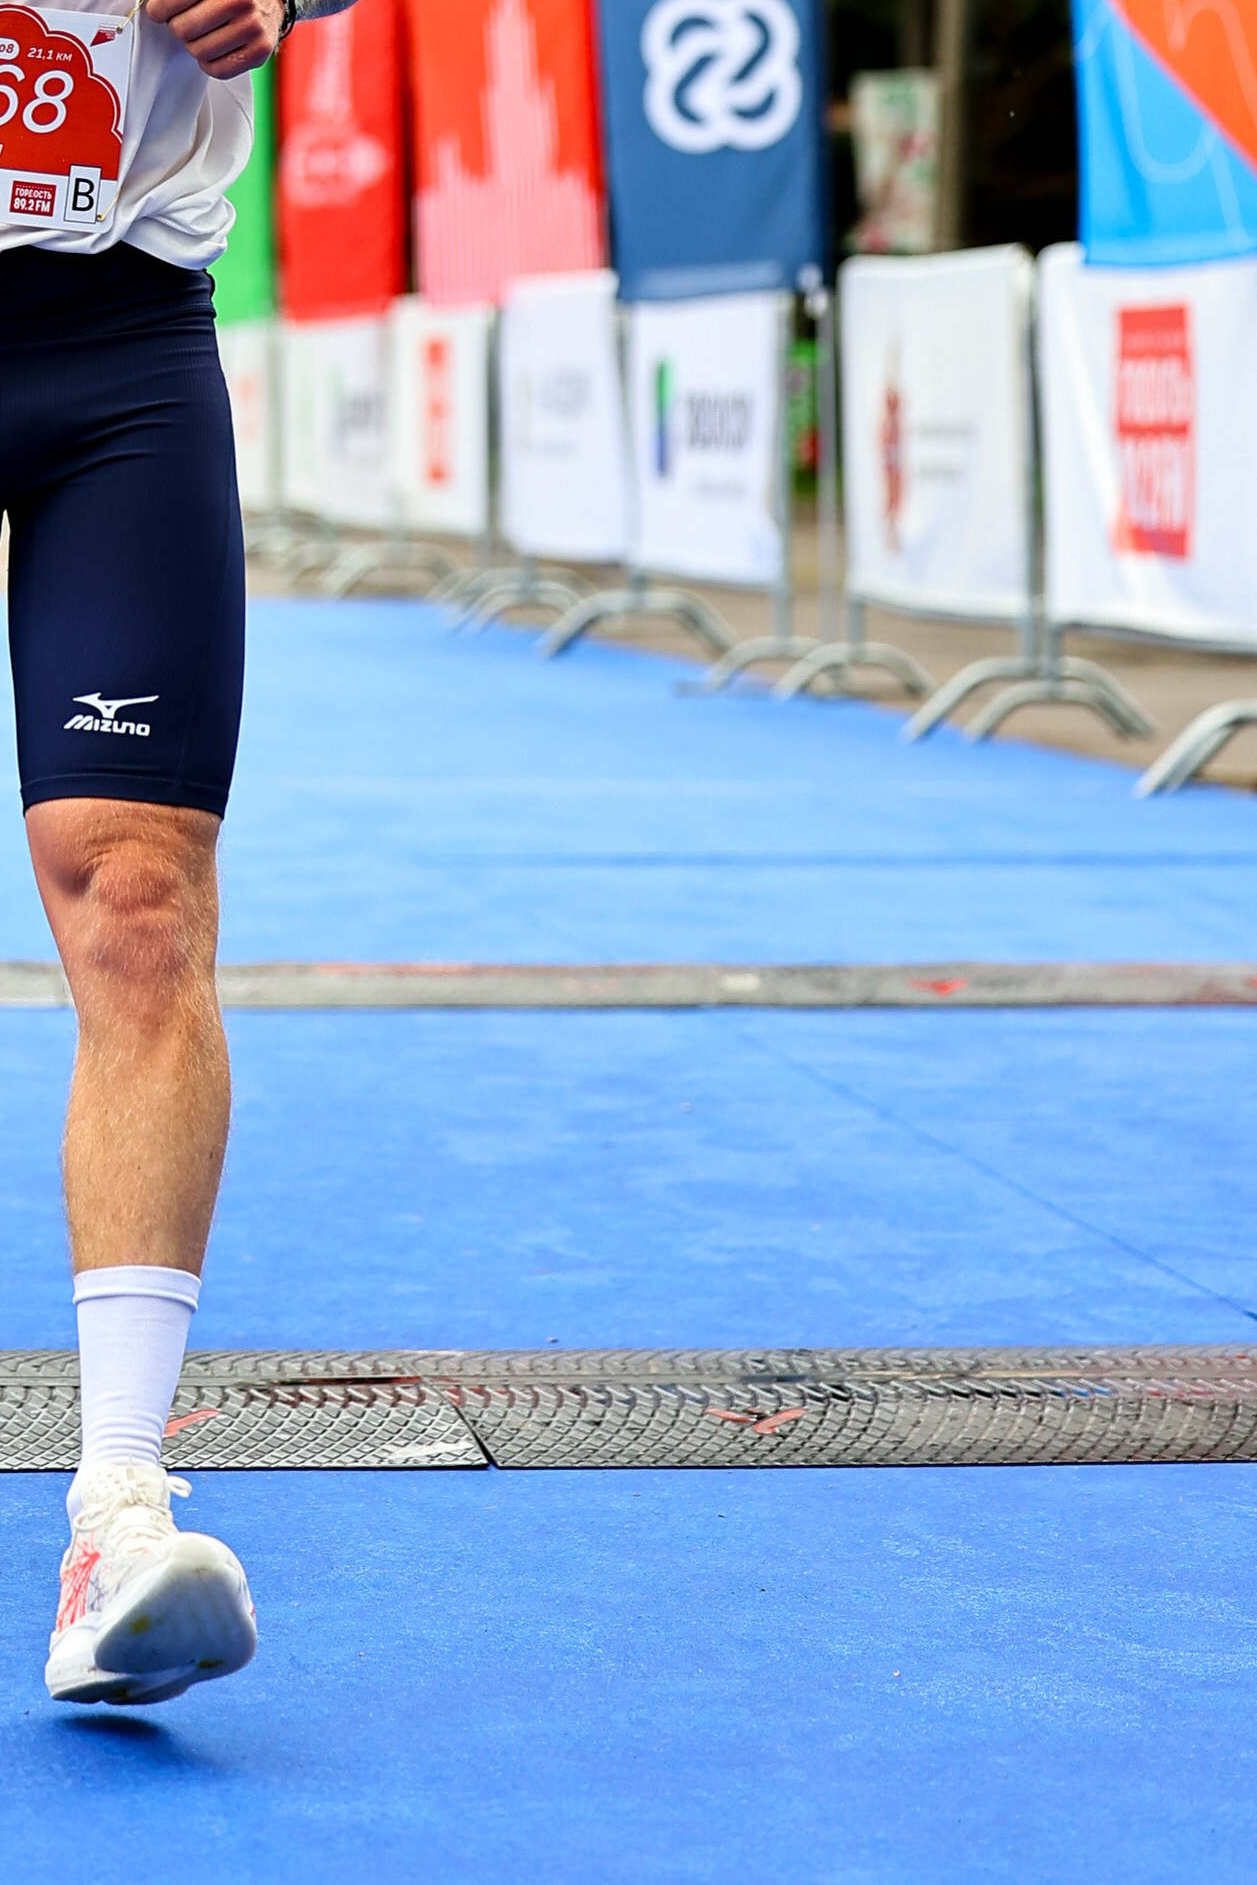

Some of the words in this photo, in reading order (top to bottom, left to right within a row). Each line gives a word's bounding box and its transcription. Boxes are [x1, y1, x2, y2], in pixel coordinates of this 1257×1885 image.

[27, 47, 54, 61] 21,1
[55, 52, 73, 62] км
[71, 177, 95, 212] B
[13, 197, 34, 211] 89.2
[35, 199, 51, 213] FM
[63, 714, 151, 736] MIZUNO
